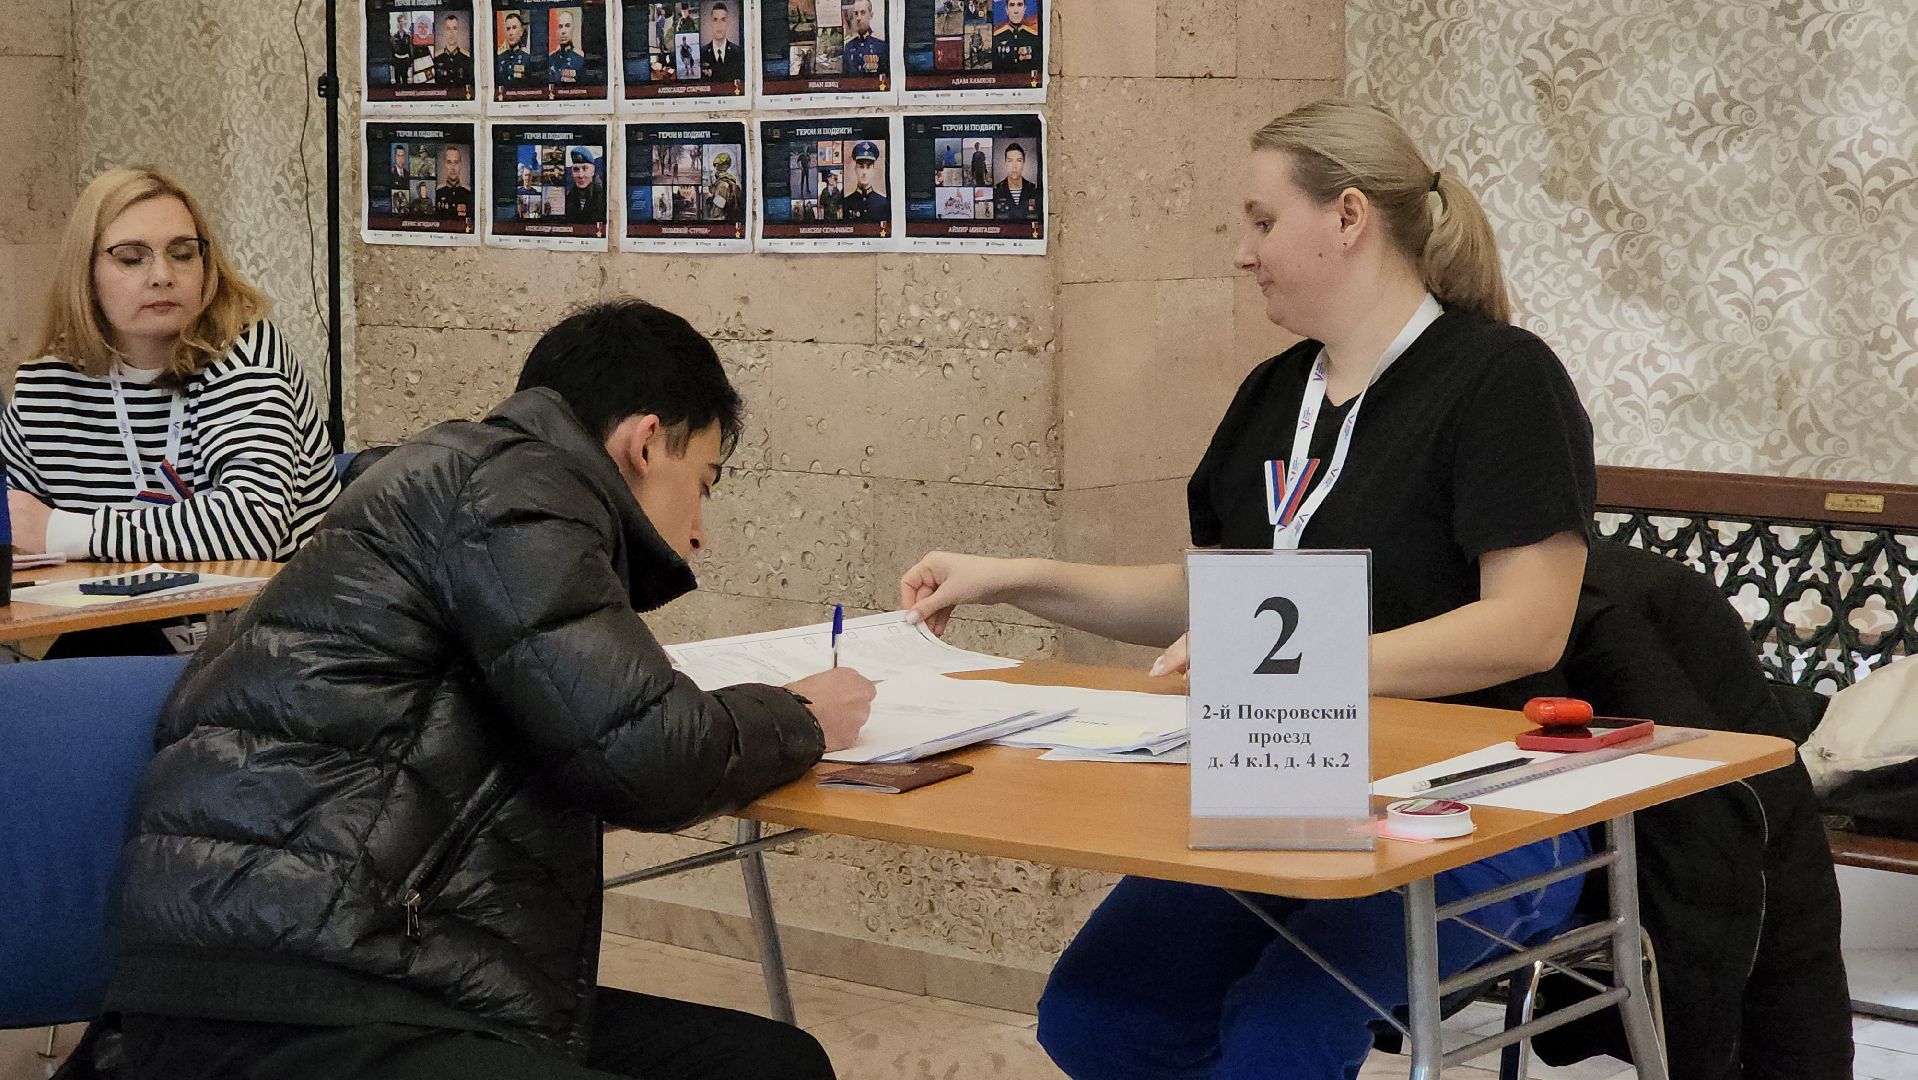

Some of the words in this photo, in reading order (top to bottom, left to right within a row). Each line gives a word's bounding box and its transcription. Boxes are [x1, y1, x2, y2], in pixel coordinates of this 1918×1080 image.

[658, 131, 677, 139] ГЕРОИ
[683, 131, 711, 139] ПОДВИГИ
[796, 128, 816, 136] ГЕРОИ
[822, 127, 852, 136] ПОДВИГИ
[970, 123, 1002, 132] ПОДВИГИ
[1252, 596, 1303, 675] 2
[1202, 704, 1231, 720] 2-й
[1238, 704, 1358, 723] Покровский
[1248, 731, 1312, 747] проезд
[1207, 755, 1224, 769] д.
[1229, 753, 1240, 768] 4
[1246, 753, 1279, 770] к.1,
[1284, 755, 1300, 769] д.
[1306, 753, 1316, 768] 4
[1322, 752, 1350, 768] к.2
